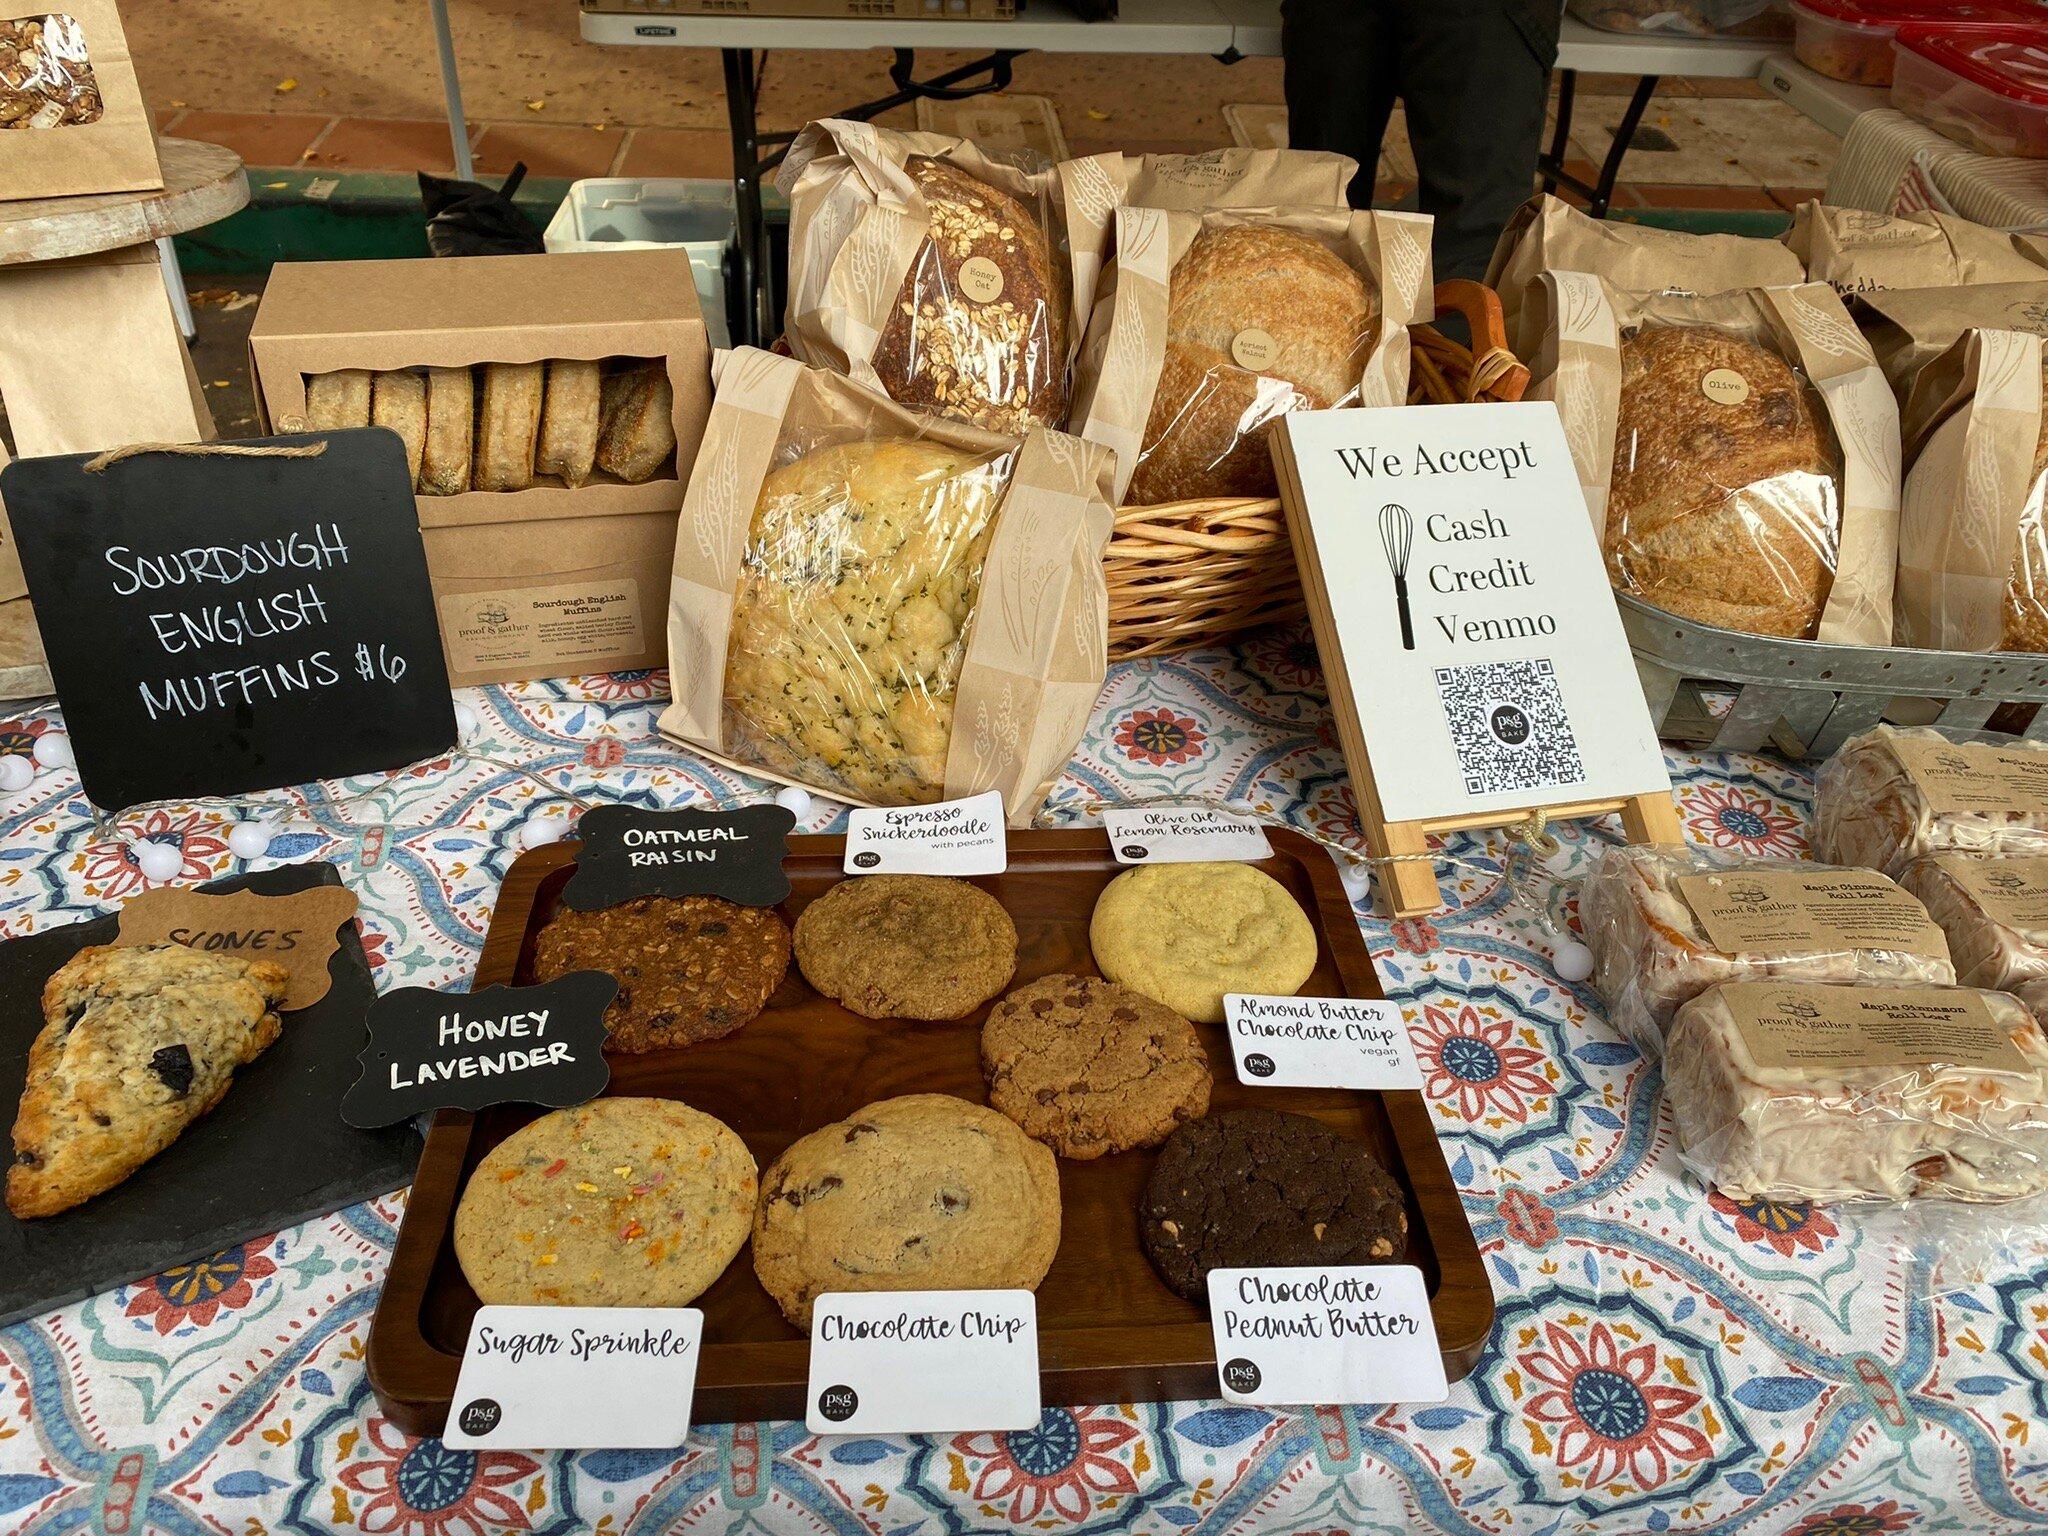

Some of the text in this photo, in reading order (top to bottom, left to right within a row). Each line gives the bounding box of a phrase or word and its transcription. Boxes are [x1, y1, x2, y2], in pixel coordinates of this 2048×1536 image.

[970, 267, 997, 282] Honey
[975, 280, 990, 290] Oat
[1240, 341, 1267, 351] Apricot
[1242, 349, 1266, 358] Walnut
[1709, 380, 1741, 390] Olive
[1334, 441, 1538, 480] We Accept
[1426, 508, 1510, 543] Cash
[104, 523, 348, 595] SOURDOUGH
[1428, 558, 1535, 593] Credit
[532, 594, 627, 609] Sourdough English
[149, 583, 327, 653] ENGLISH
[563, 606, 602, 615] Muffins
[459, 624, 530, 637] proof & gather
[1433, 613, 1557, 644] Venmo
[138, 642, 407, 720] MUFFINS $6
[1496, 712, 1523, 730] p&g
[1501, 730, 1525, 738] BAKE
[1923, 767, 1951, 776] proof
[885, 807, 964, 827] Espresso
[1144, 812, 1218, 825] Olive Oil
[623, 827, 749, 847] OATMEAL
[862, 818, 991, 840] Snickerdoodle
[1114, 824, 1256, 838] Lemon Rosemary
[931, 837, 994, 849] with pecans
[628, 849, 717, 867] RAISIN
[1802, 883, 1896, 893] Maple Cinnamon
[1711, 901, 1798, 917] proof & gather
[1240, 998, 1385, 1021] Almond Butter
[1860, 1002, 1967, 1013] Maple Cinnamon
[1757, 1017, 1852, 1030] proof & gather
[1921, 1013, 1952, 1021] Loaf
[438, 1009, 549, 1047] HONEY
[1237, 1019, 1398, 1045] Chocolate Chip
[1359, 1047, 1398, 1056] vegan
[390, 1042, 576, 1090] LAVENDER
[1248, 1058, 1270, 1069] p&g
[1388, 1058, 1400, 1067] gf
[1239, 1274, 1382, 1305] Chocolate
[821, 1311, 1027, 1344] Chocolate Chip
[1224, 1308, 1419, 1339] Peanut Butter
[478, 1326, 691, 1364] Sugar Sprinkle
[1229, 1365, 1255, 1380] p&g
[826, 1391, 853, 1408] p&g
[467, 1405, 497, 1422] p&g
